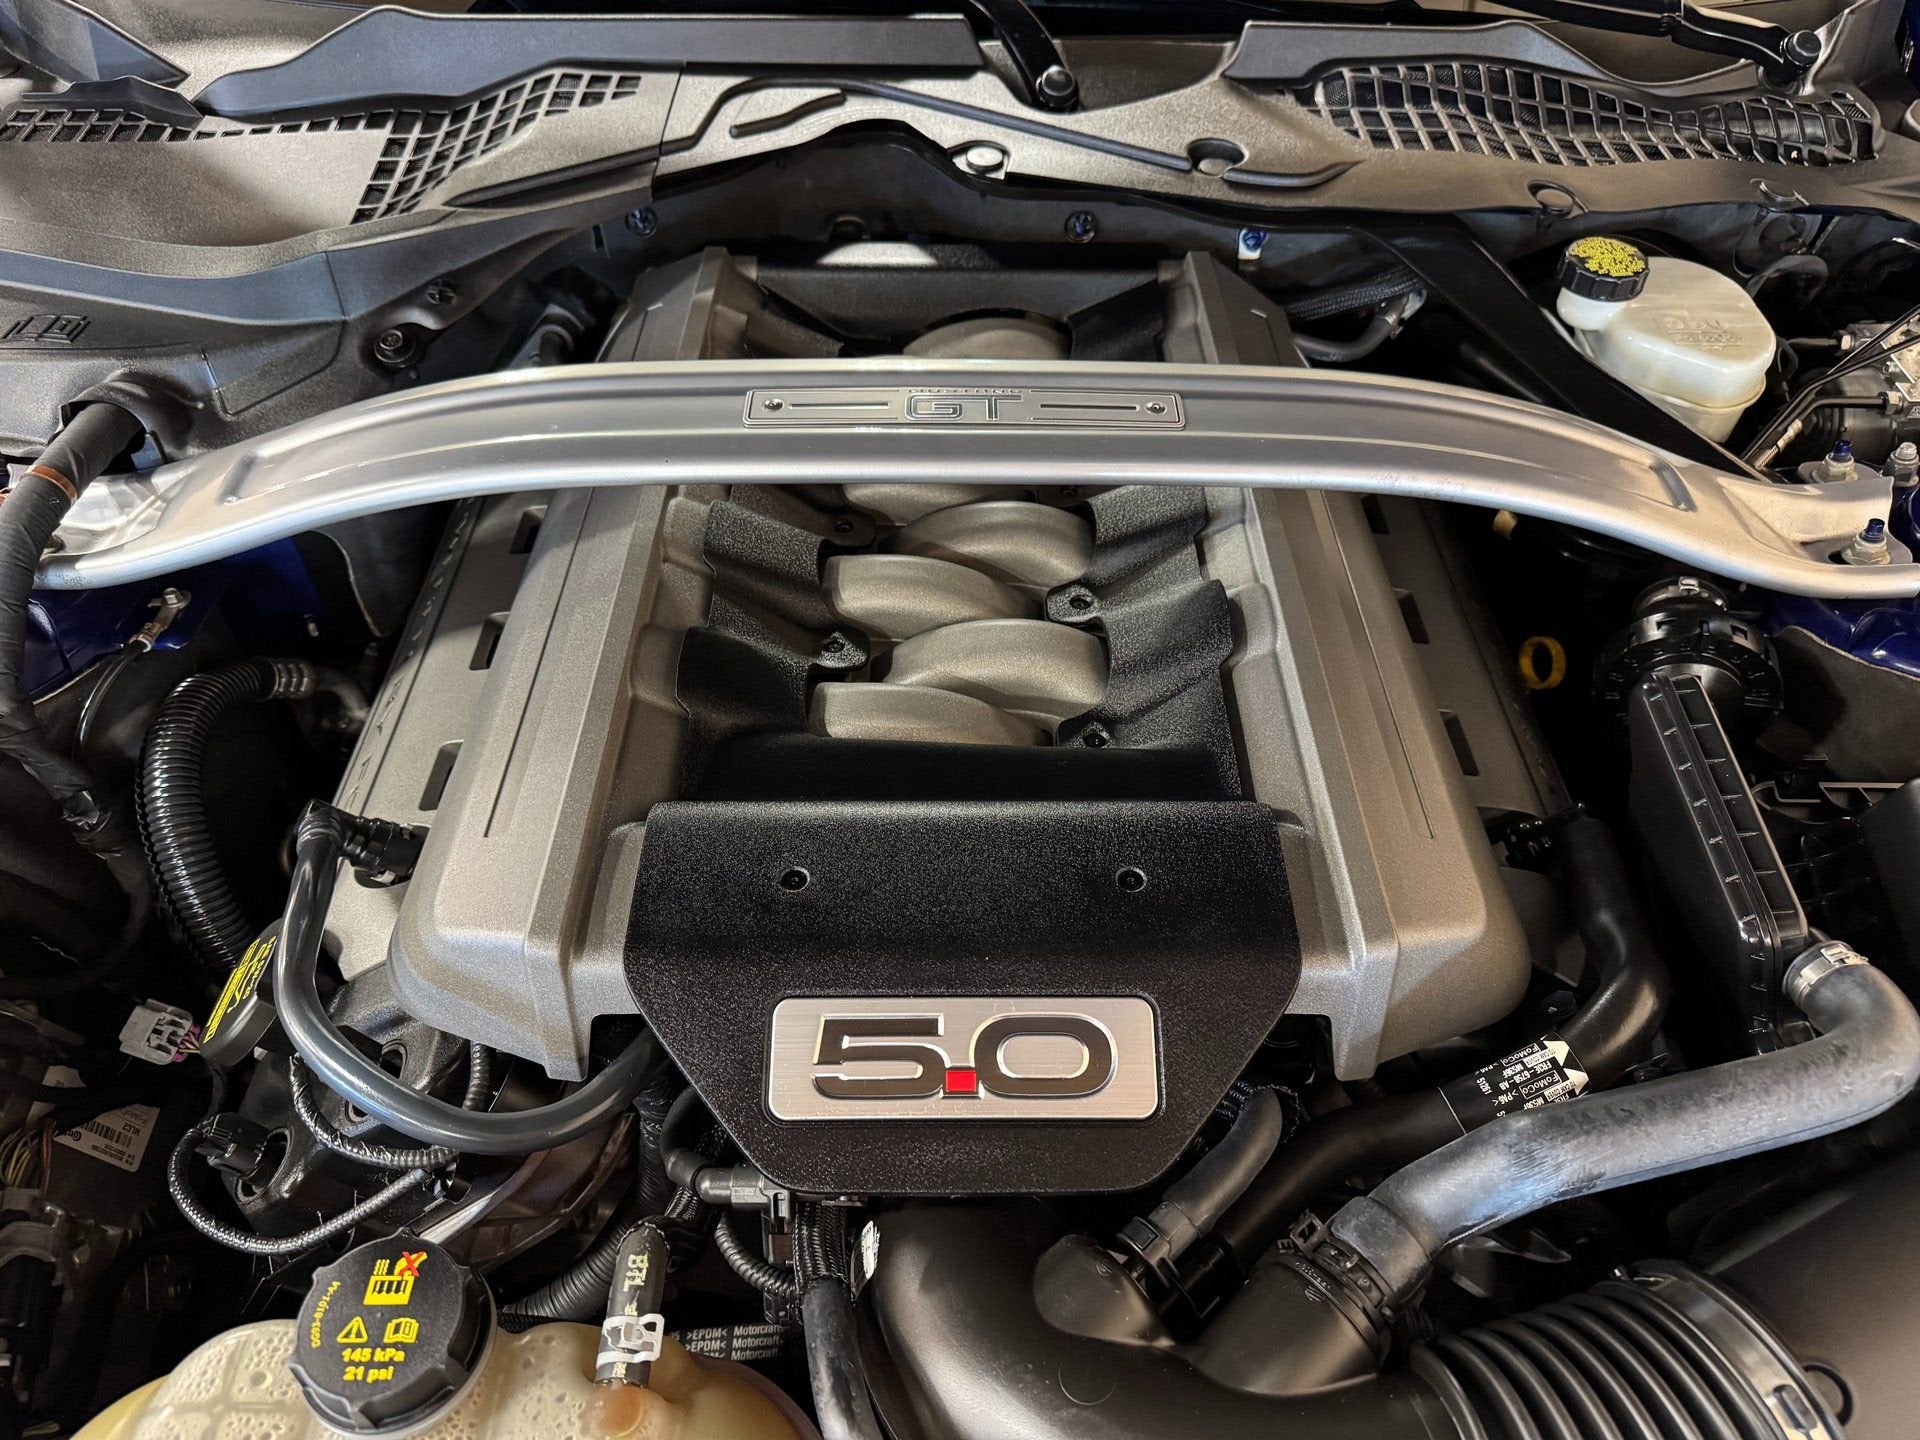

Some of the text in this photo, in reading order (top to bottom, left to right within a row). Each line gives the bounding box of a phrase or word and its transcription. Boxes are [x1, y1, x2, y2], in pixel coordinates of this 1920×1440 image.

[905, 393, 1023, 421] GT
[812, 1012, 1119, 1099] 5.0
[1503, 1045, 1542, 1065] FoMoCo
[1522, 1073, 1559, 1095] FoMoCo
[732, 1335, 780, 1349] Motorcraft
[342, 1347, 405, 1362] 145 kPa
[343, 1365, 394, 1383] 21 psi
